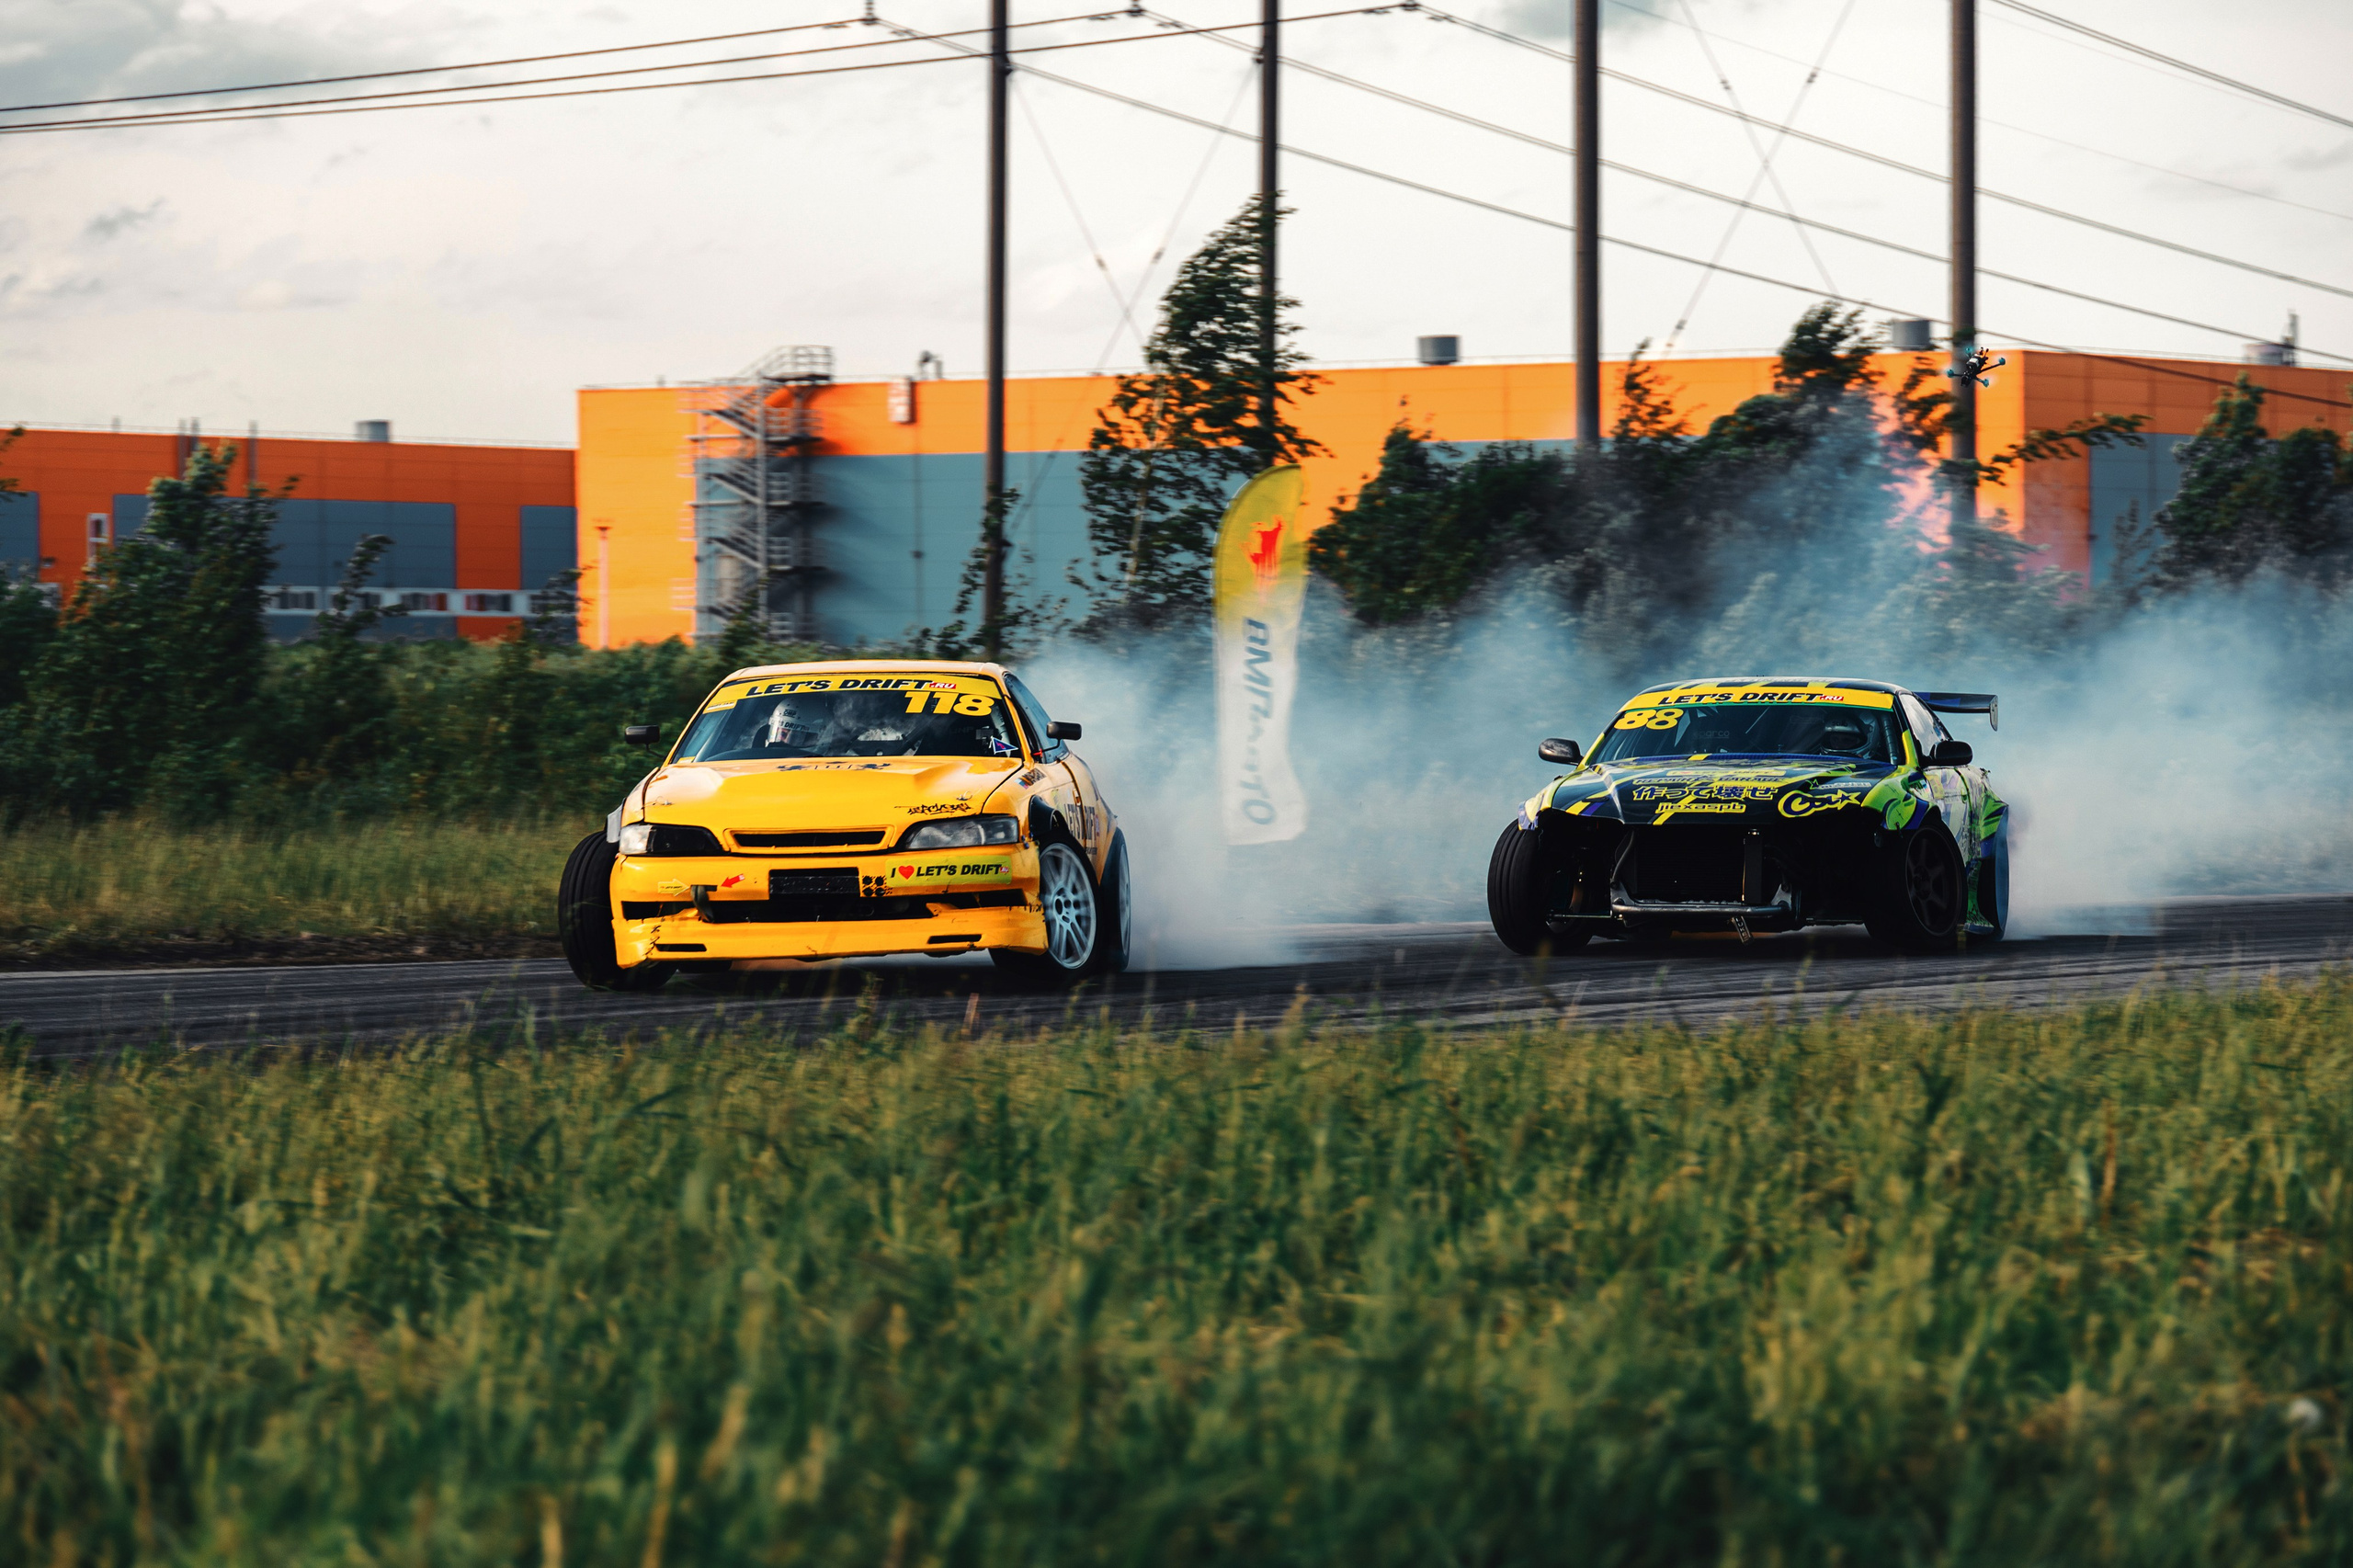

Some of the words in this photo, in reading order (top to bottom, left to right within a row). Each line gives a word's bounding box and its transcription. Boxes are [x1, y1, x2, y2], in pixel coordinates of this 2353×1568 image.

[745, 679, 833, 697] LET'S
[904, 691, 995, 716] 118
[1657, 692, 1735, 705] LET'S
[1613, 708, 1684, 730] 88
[890, 867, 896, 879] I
[916, 864, 957, 877] LET'S
